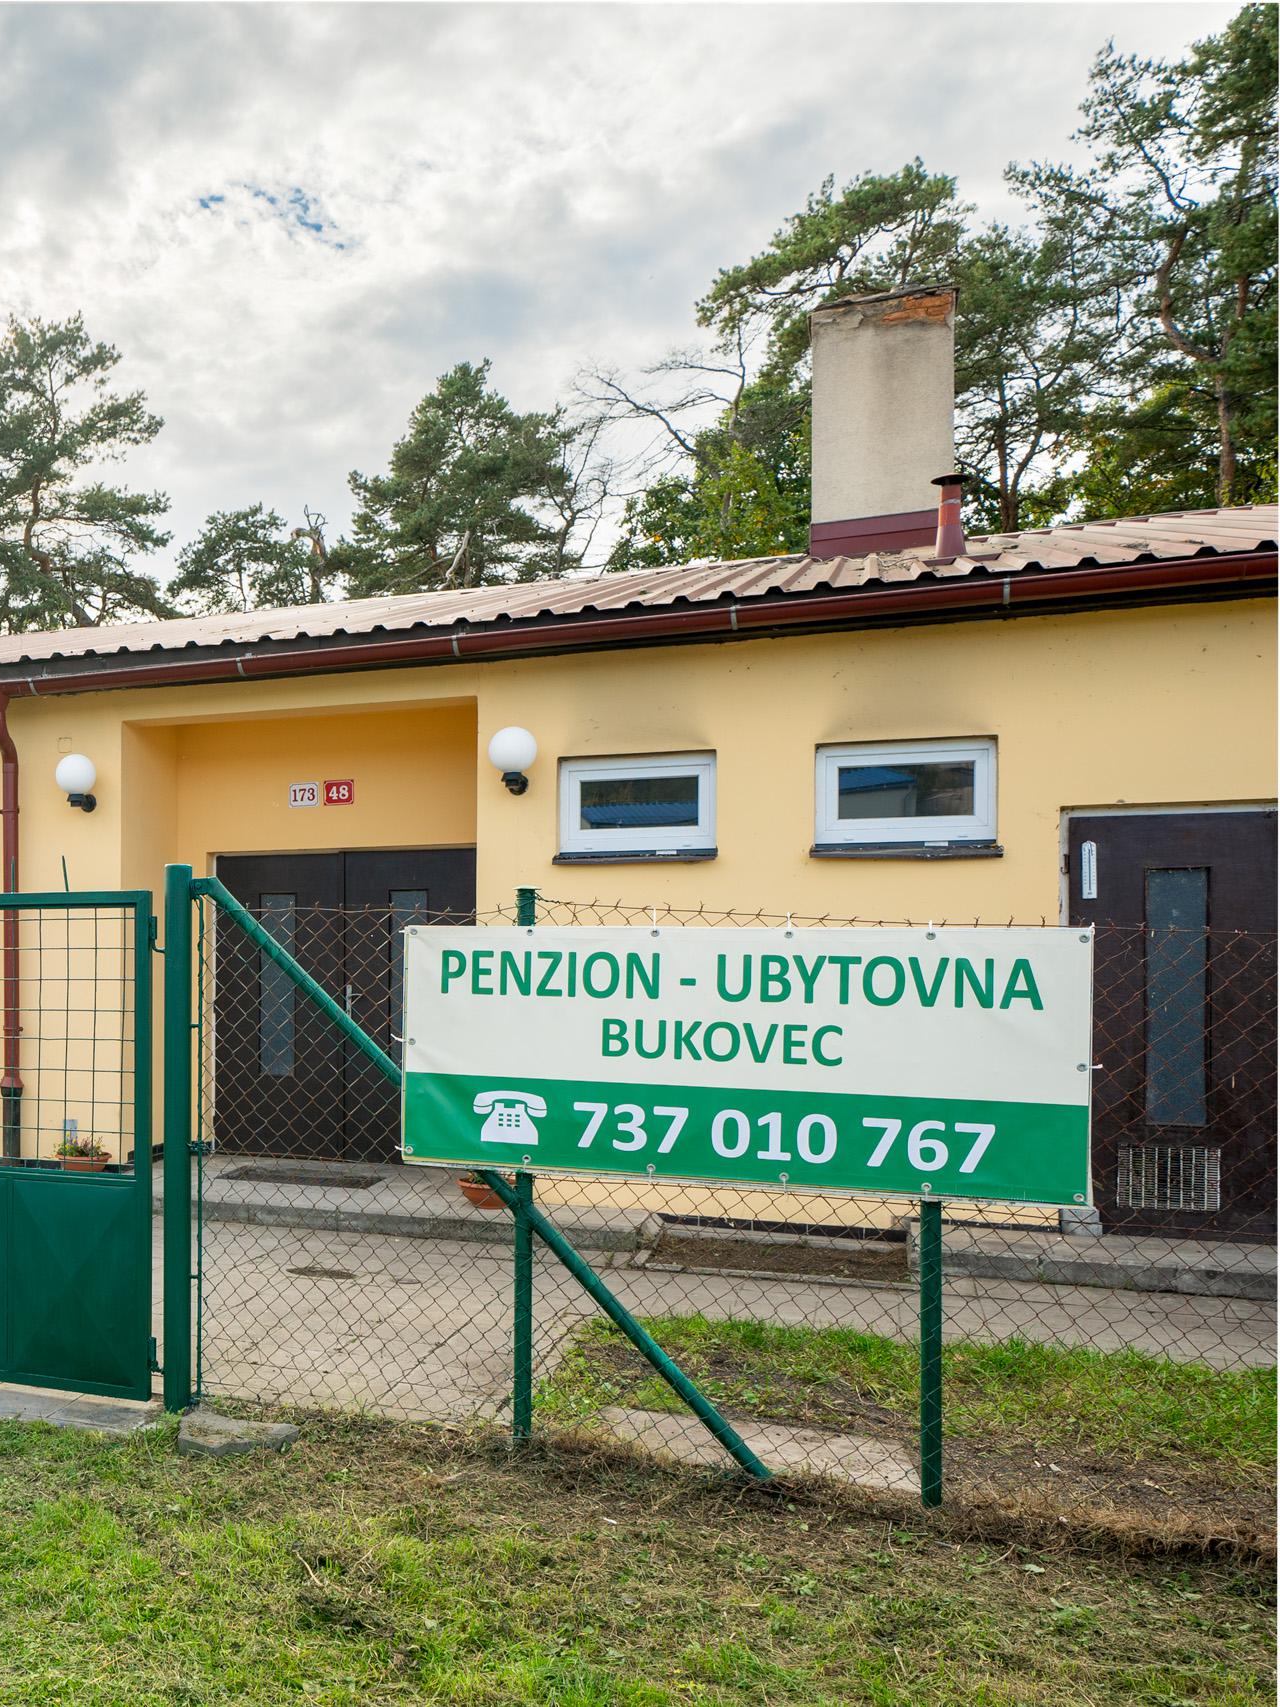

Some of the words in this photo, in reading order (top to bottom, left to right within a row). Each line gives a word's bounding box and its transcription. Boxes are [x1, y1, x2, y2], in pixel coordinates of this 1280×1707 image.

[292, 788, 315, 802] 173
[328, 785, 349, 800] 48
[440, 949, 661, 1001] PENZION
[716, 953, 1045, 1012] UBYTOVNA
[601, 1017, 845, 1068] BUKOVEC
[573, 1101, 689, 1154] 737
[711, 1109, 838, 1164] 010
[862, 1117, 996, 1174] 767
